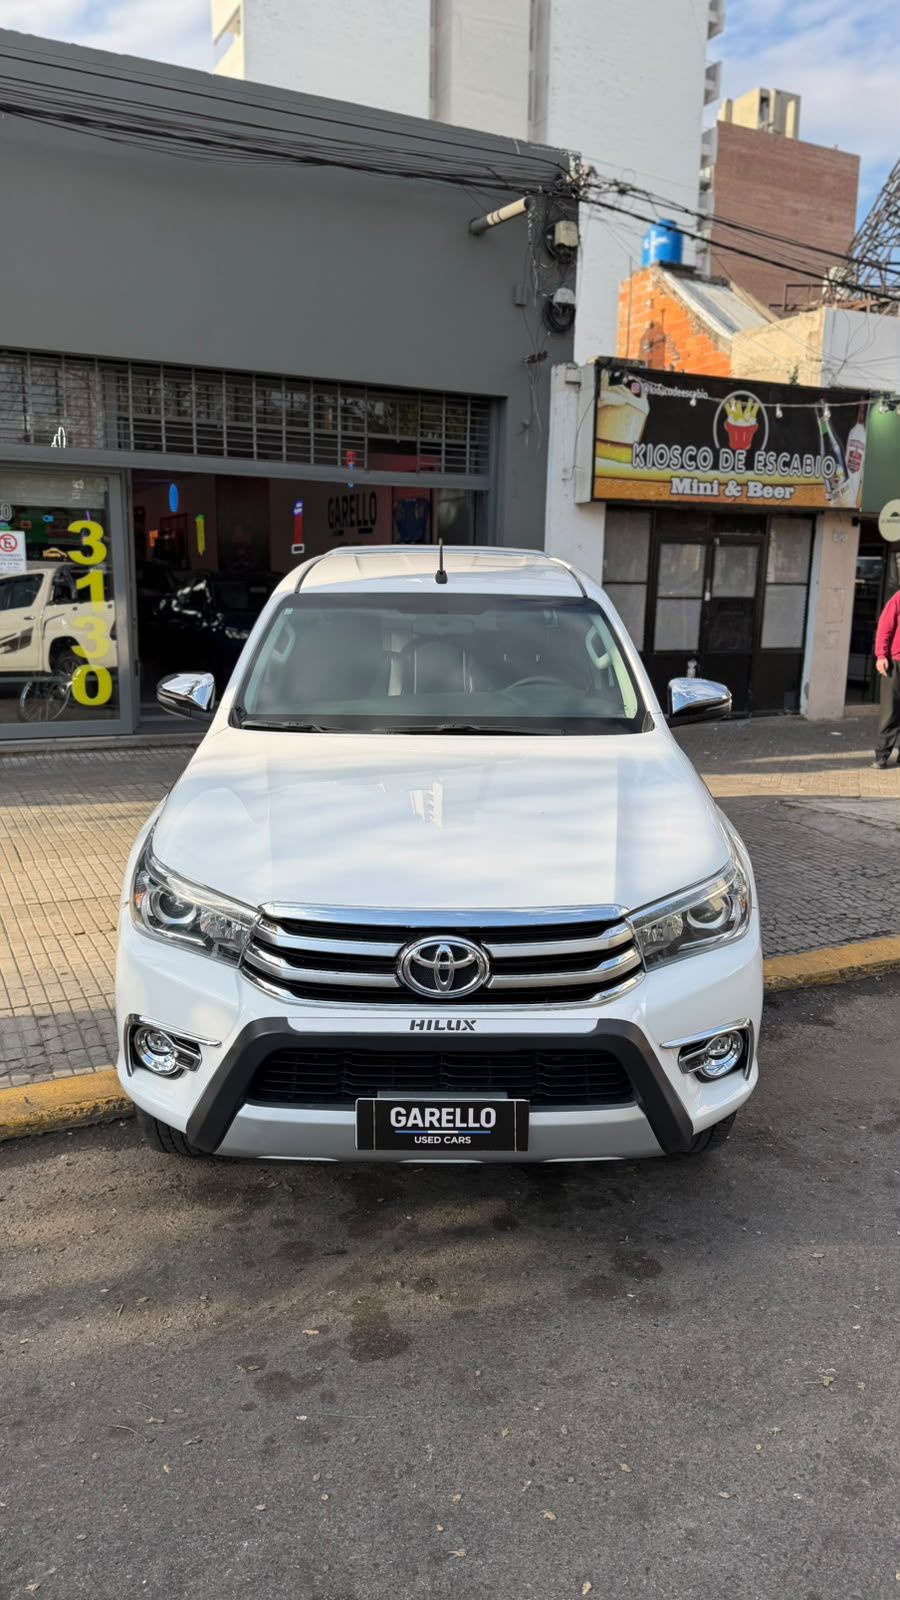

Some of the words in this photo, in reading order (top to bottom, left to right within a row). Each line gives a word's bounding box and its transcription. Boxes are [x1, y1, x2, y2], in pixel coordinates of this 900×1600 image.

[632, 442, 713, 471] KIOSCO
[719, 448, 746, 474] DE
[754, 450, 836, 479] ESCABIO
[671, 477, 720, 496] Mini
[724, 480, 743, 497] &
[747, 481, 795, 499] Beer
[328, 491, 377, 529] GARELLO
[409, 1019, 477, 1031] HILUX
[390, 1107, 496, 1128] GARELLO
[414, 1136, 441, 1144] USED
[443, 1136, 471, 1144] CARS
